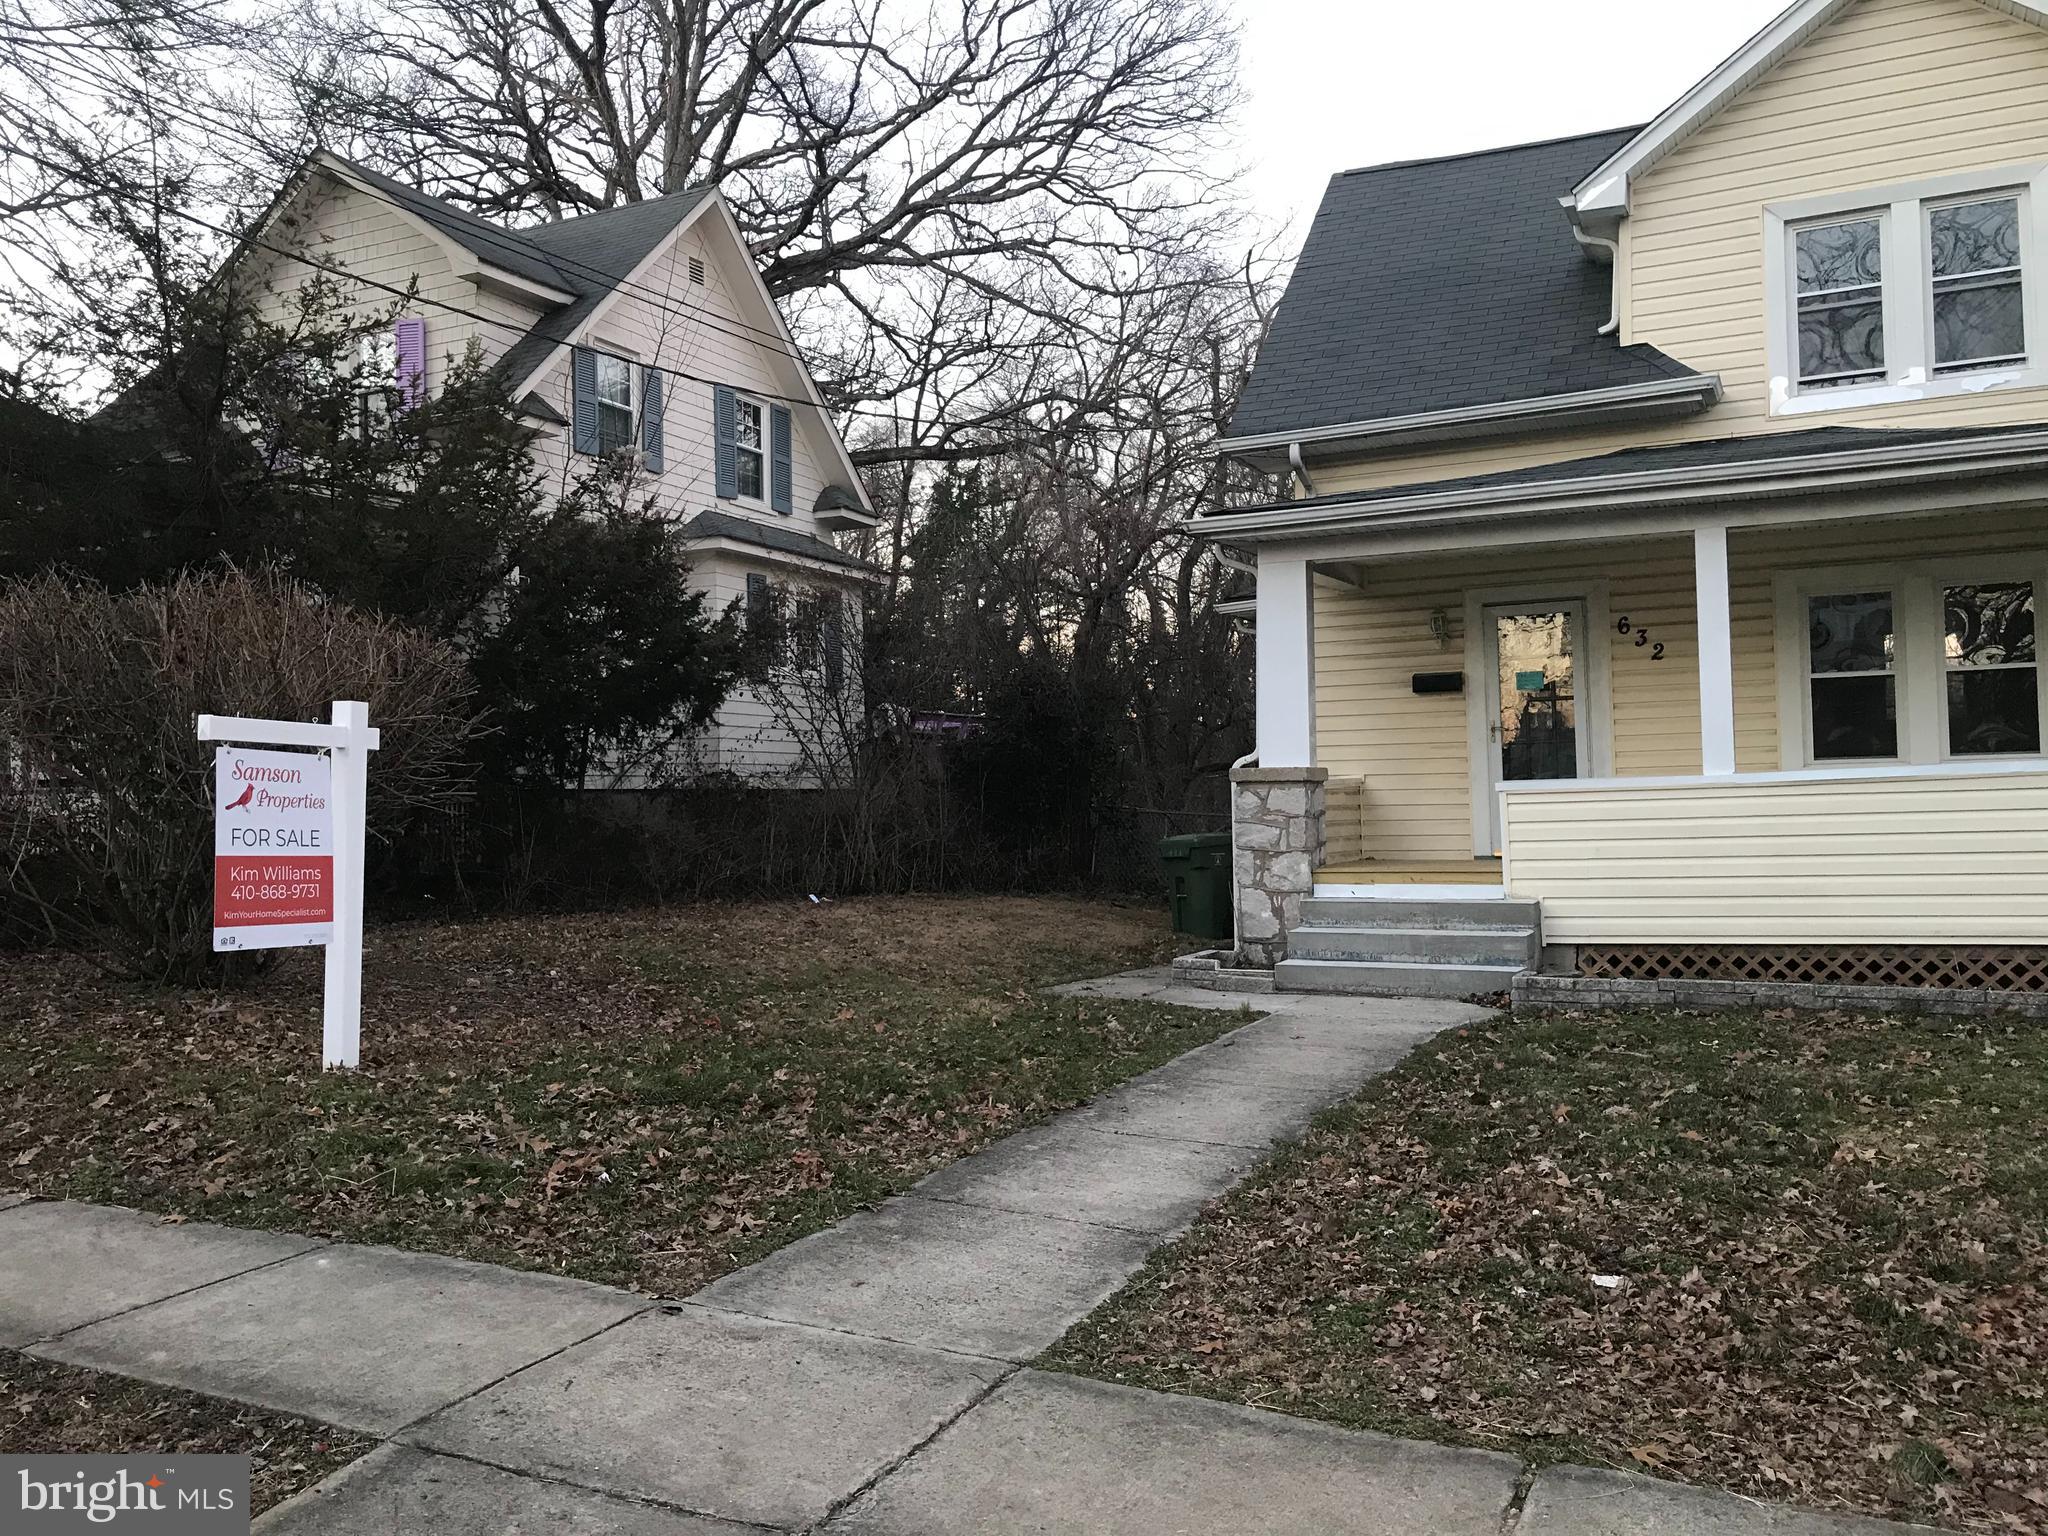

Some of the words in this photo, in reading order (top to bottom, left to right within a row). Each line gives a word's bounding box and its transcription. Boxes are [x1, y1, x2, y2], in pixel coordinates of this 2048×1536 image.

[1617, 616, 1664, 661] 632
[231, 759, 301, 784] Samson
[256, 788, 325, 813] Properties
[231, 828, 271, 847] FOR
[276, 829, 320, 847] SALE
[230, 866, 259, 882] Kim
[262, 866, 321, 881] Williams
[231, 884, 320, 900] 410-868-9731
[224, 907, 326, 919] KimYourHomeSpecialist.com
